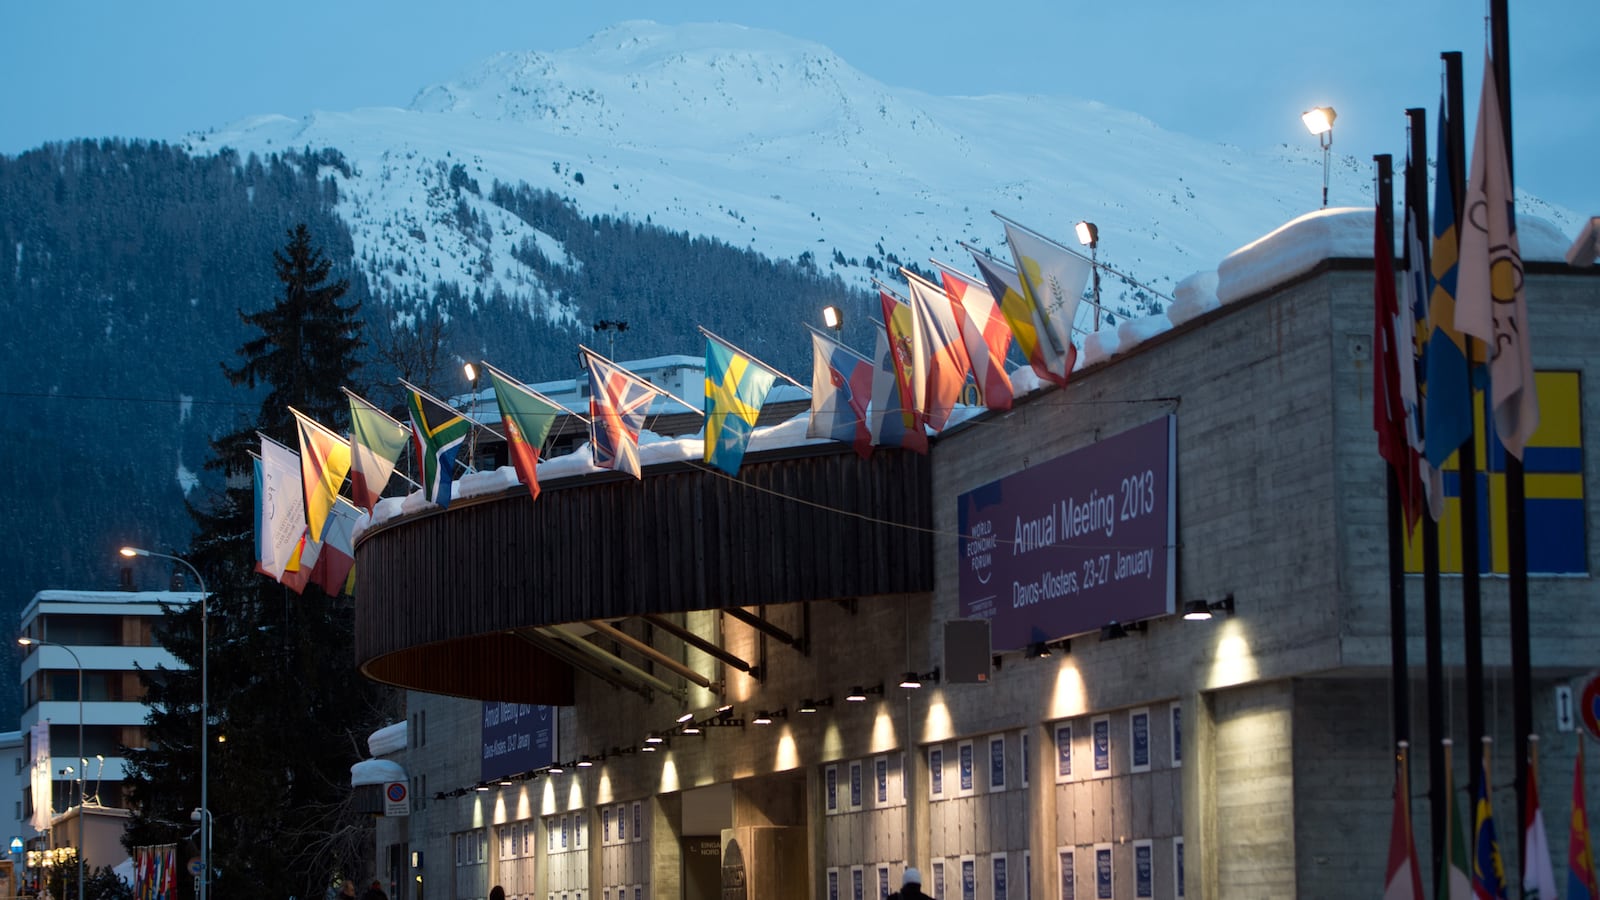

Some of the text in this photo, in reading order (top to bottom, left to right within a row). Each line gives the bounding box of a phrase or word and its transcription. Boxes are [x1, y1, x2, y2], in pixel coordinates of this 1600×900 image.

[1013, 470, 1154, 555] Annual Meeting 2013
[971, 520, 992, 538] WORLD
[967, 534, 997, 556] ECONOMIC
[971, 552, 992, 572] FORUM
[1013, 549, 1154, 608] Davos-Klosters, 23-27 January
